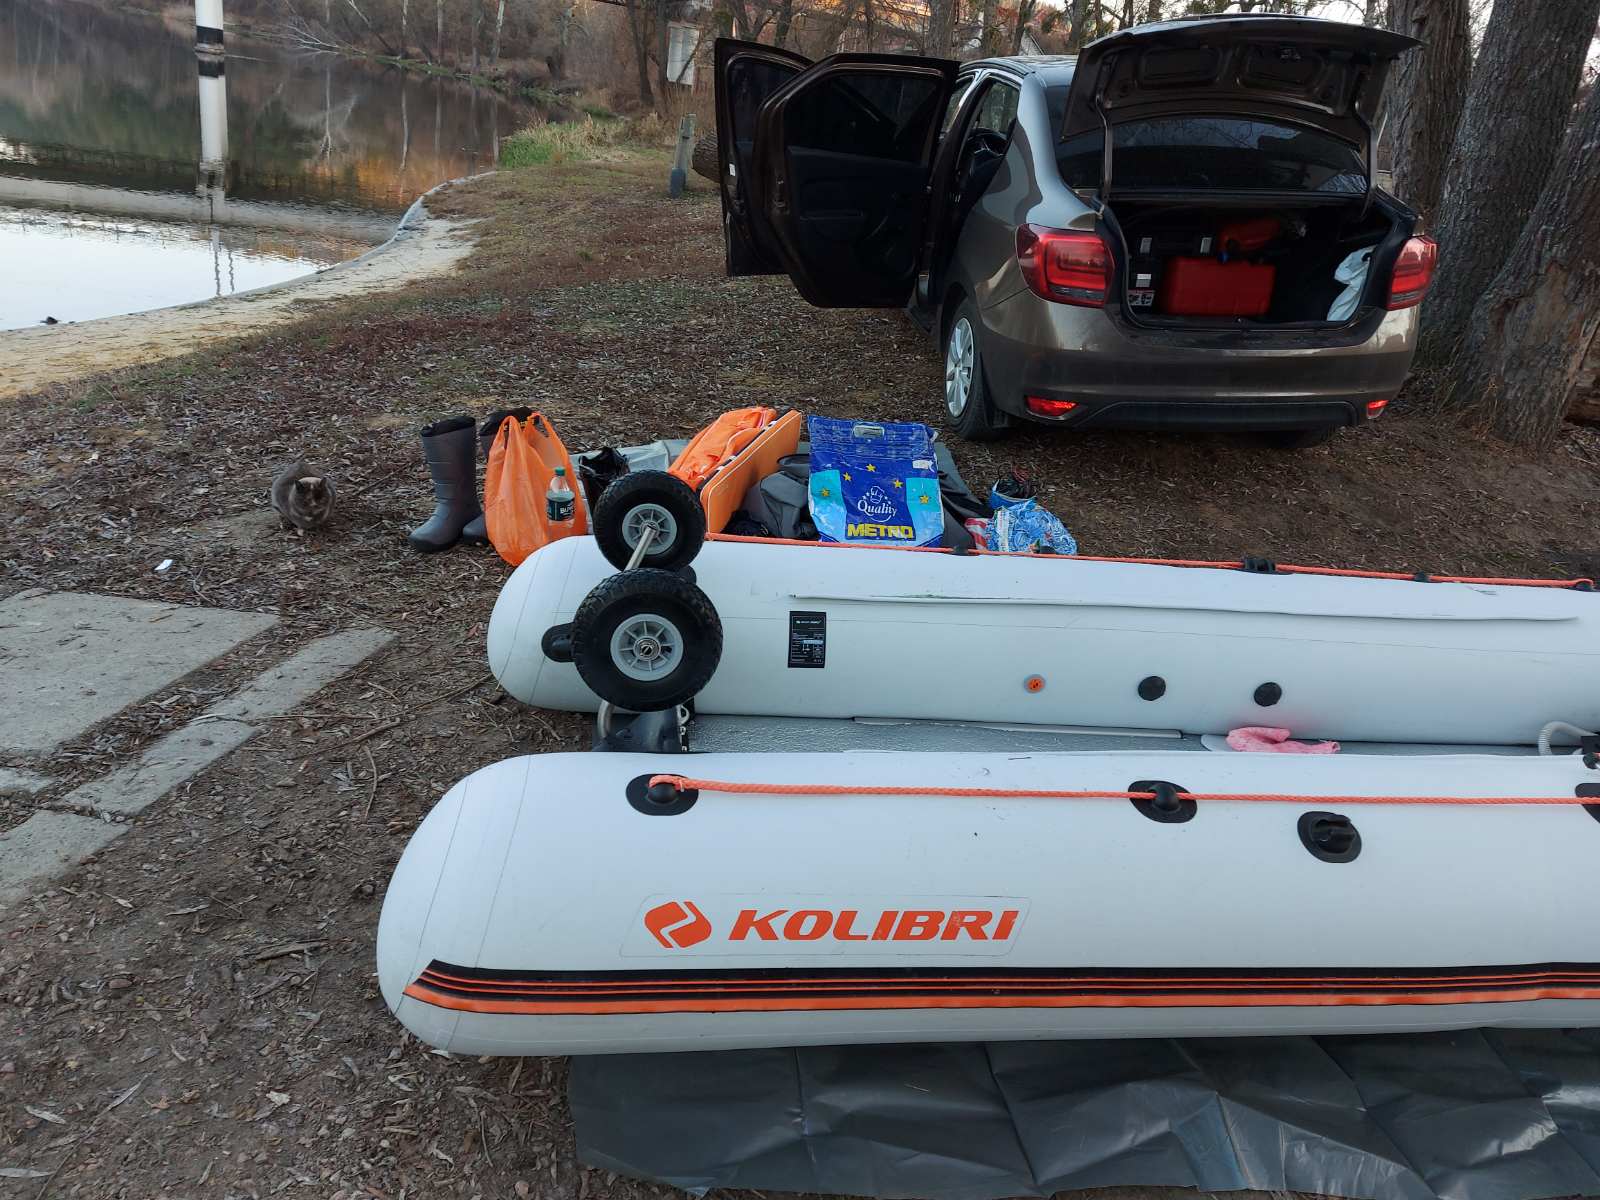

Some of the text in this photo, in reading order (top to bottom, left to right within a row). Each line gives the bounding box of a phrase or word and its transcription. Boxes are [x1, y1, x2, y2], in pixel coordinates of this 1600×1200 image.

[858, 499, 897, 517] Quality
[848, 523, 914, 539] METRO
[728, 909, 1019, 940] KOLIBRI
